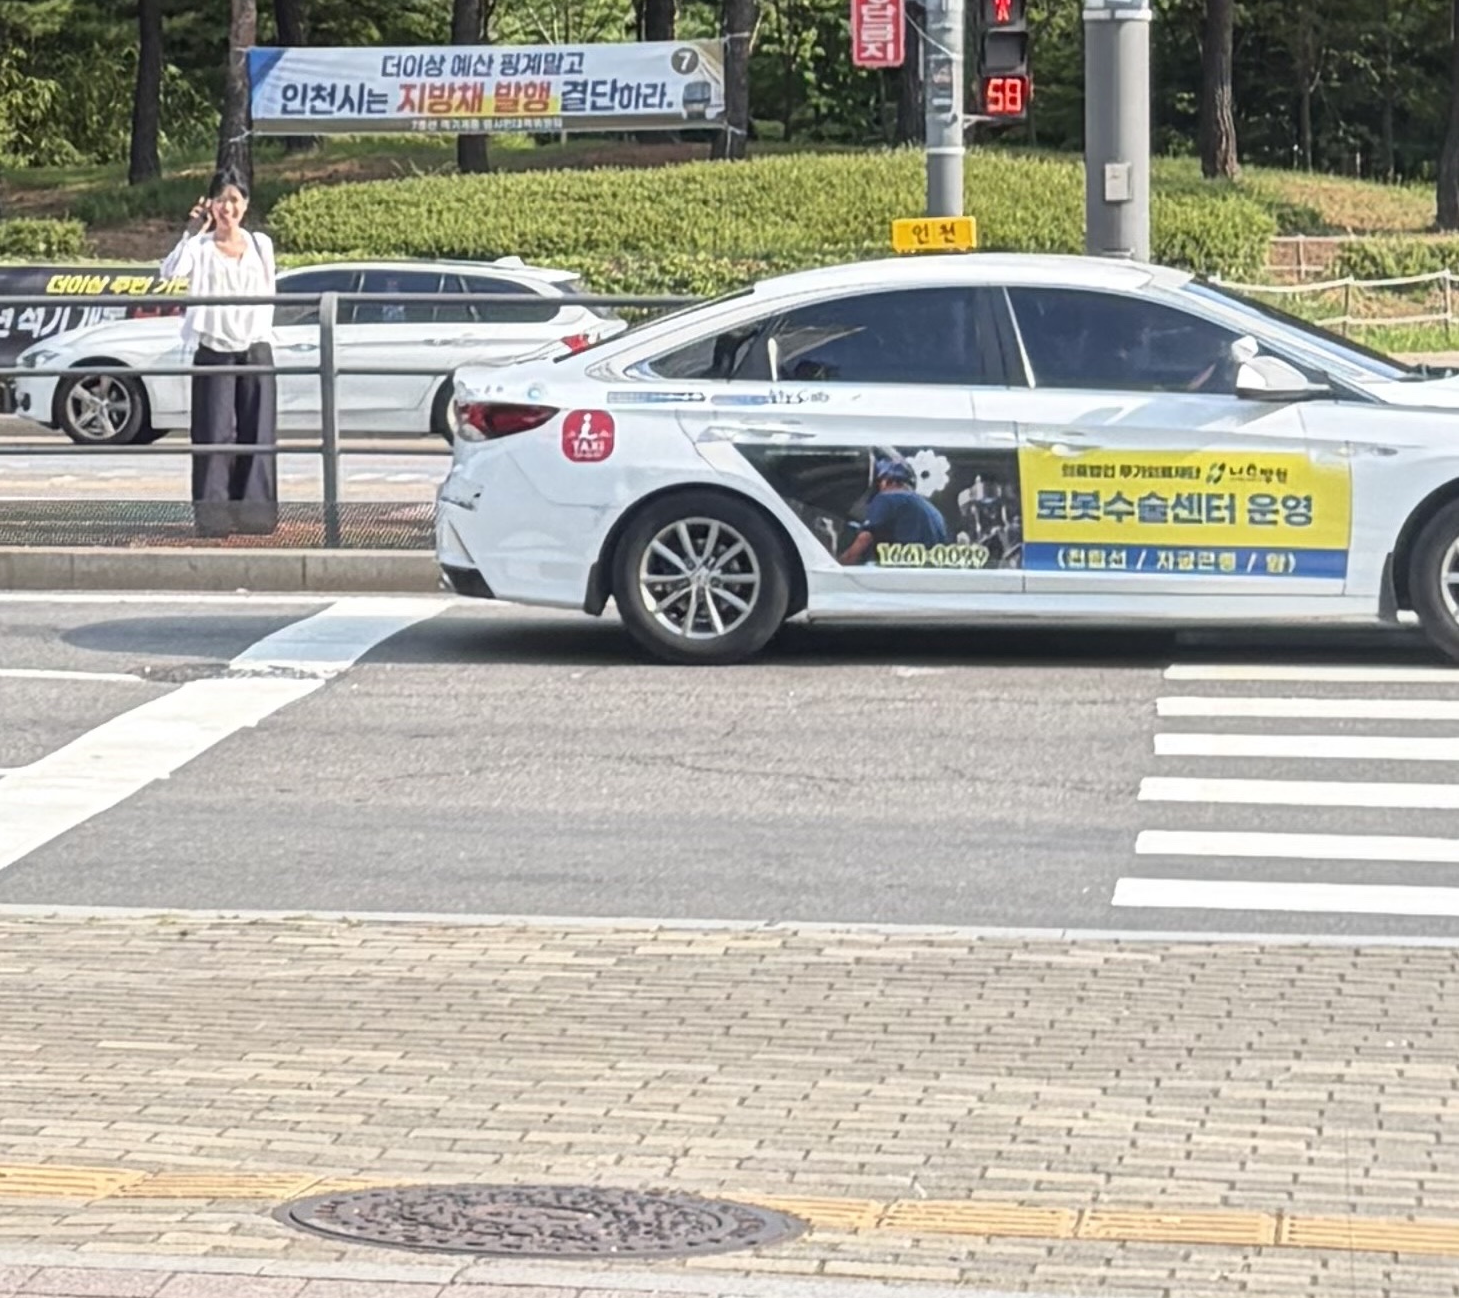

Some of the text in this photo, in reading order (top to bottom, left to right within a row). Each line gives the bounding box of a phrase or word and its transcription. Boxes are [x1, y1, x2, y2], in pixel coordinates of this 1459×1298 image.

[381, 51, 584, 78] 더이상 예산 핑계말고
[678, 52, 692, 72] 7
[281, 78, 673, 115] 인천시는 지방채 발행 결단하라.
[987, 78, 1022, 112] 58
[46, 274, 110, 294] 더이상
[1036, 489, 1314, 526] 로봇수술센터 운영
